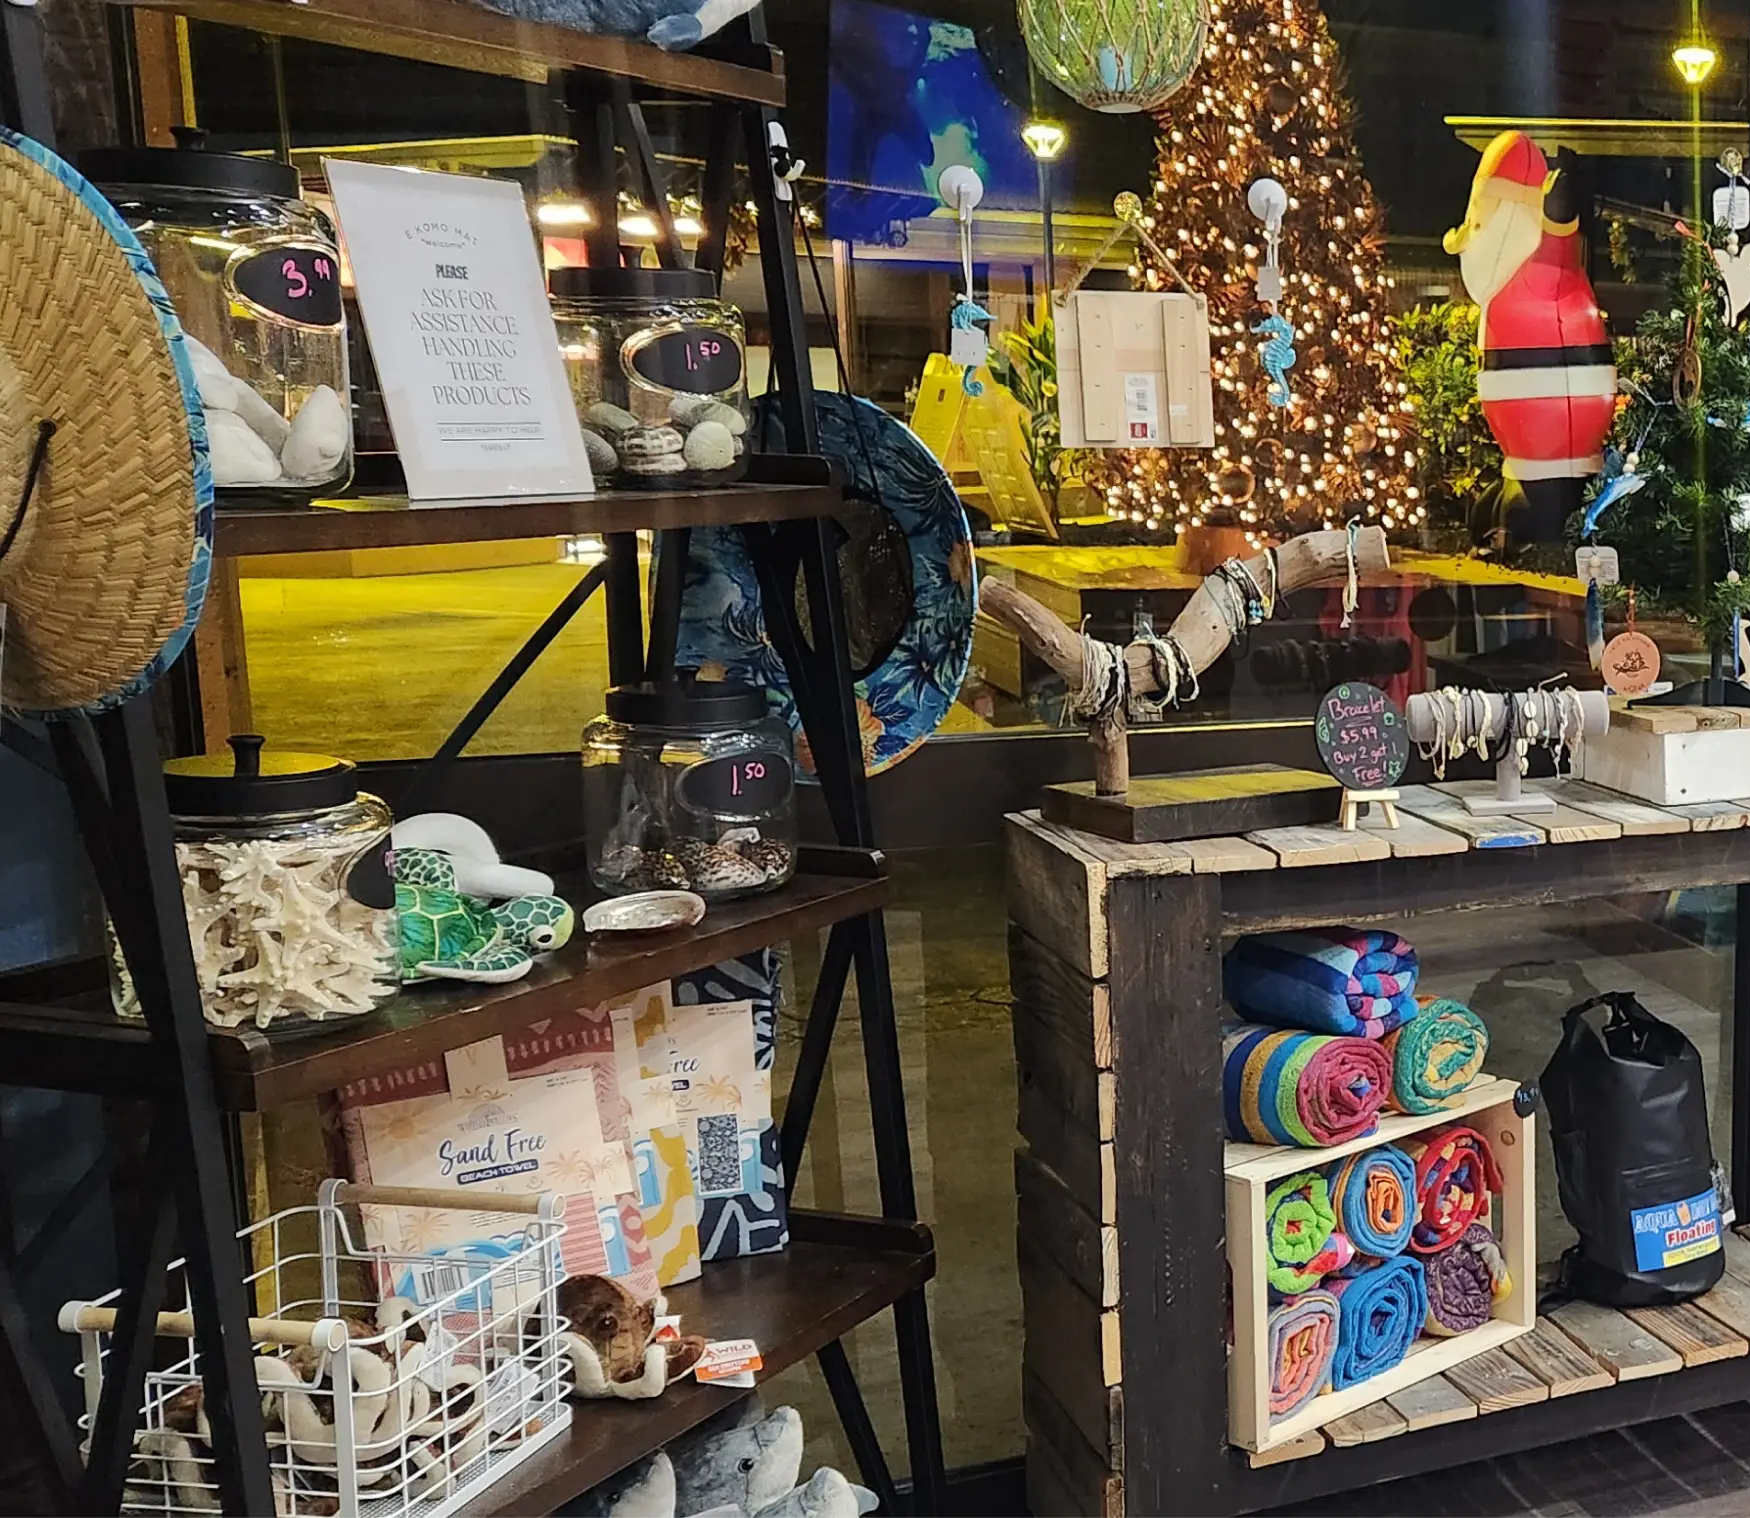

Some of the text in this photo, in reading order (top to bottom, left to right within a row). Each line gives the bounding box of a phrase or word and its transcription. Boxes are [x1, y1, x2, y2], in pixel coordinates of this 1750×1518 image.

[414, 222, 449, 234] KOMO
[435, 263, 469, 280] PLEASE
[421, 287, 498, 311] ASK FOR
[410, 312, 519, 335] ASSISTANCE
[421, 336, 517, 359] HANDLING
[685, 341, 721, 370] 1.50
[446, 361, 507, 382] THESE
[432, 385, 532, 406] PRODUCTS
[439, 426, 453, 435] WE
[456, 426, 473, 435] ARE
[1327, 695, 1386, 721] Bracelet
[1340, 726, 1378, 744] $5.99
[1333, 751, 1357, 765] Buy
[1358, 746, 1369, 759] 2
[1370, 742, 1387, 764] get
[731, 762, 766, 796] 1.50
[1351, 760, 1387, 783] Free!
[439, 1128, 547, 1176] Sand Free
[459, 1160, 538, 1184] BEACH TOWEL
[1634, 1208, 1679, 1234] AQUA
[715, 1342, 753, 1354] WILD
